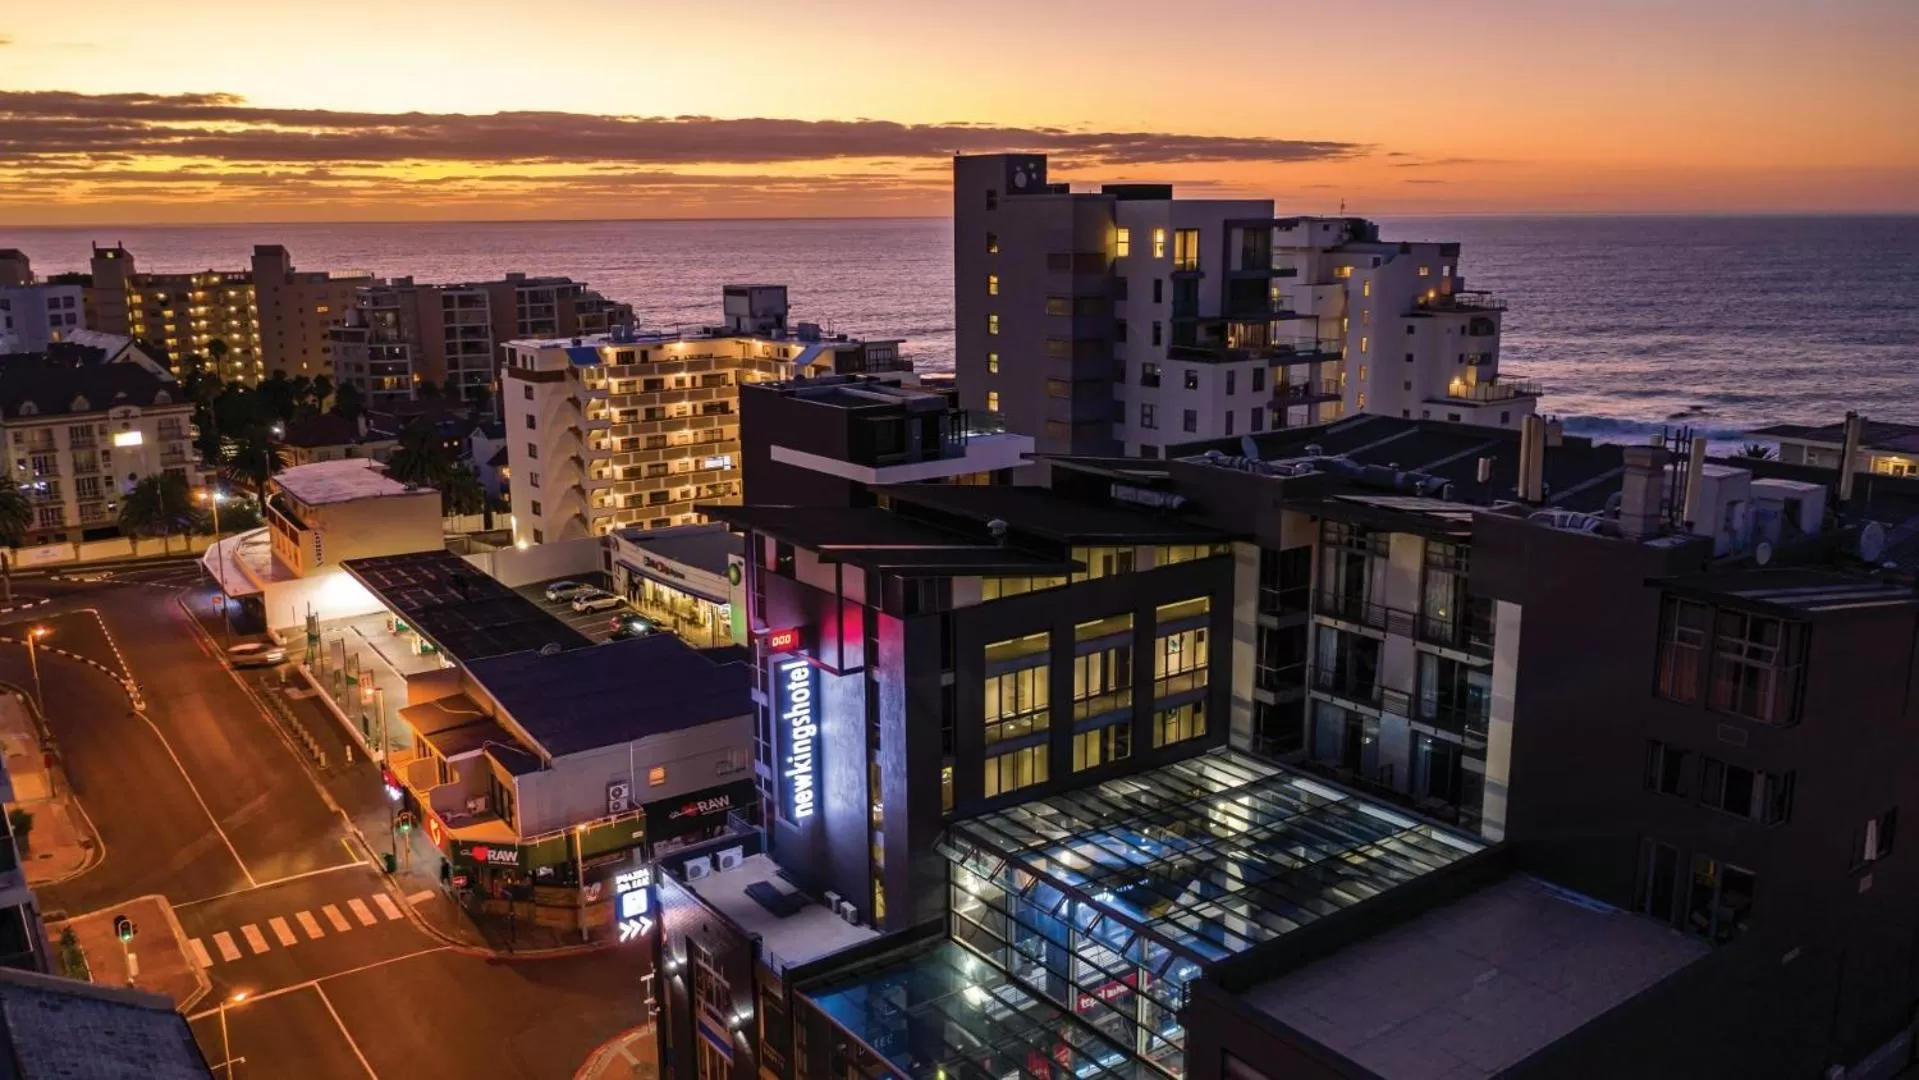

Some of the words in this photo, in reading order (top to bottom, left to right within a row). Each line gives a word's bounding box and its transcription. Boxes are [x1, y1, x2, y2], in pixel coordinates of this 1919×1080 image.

[781, 660, 817, 818] newkingshotel
[697, 794, 730, 812] RAW
[487, 849, 518, 862] RAW
